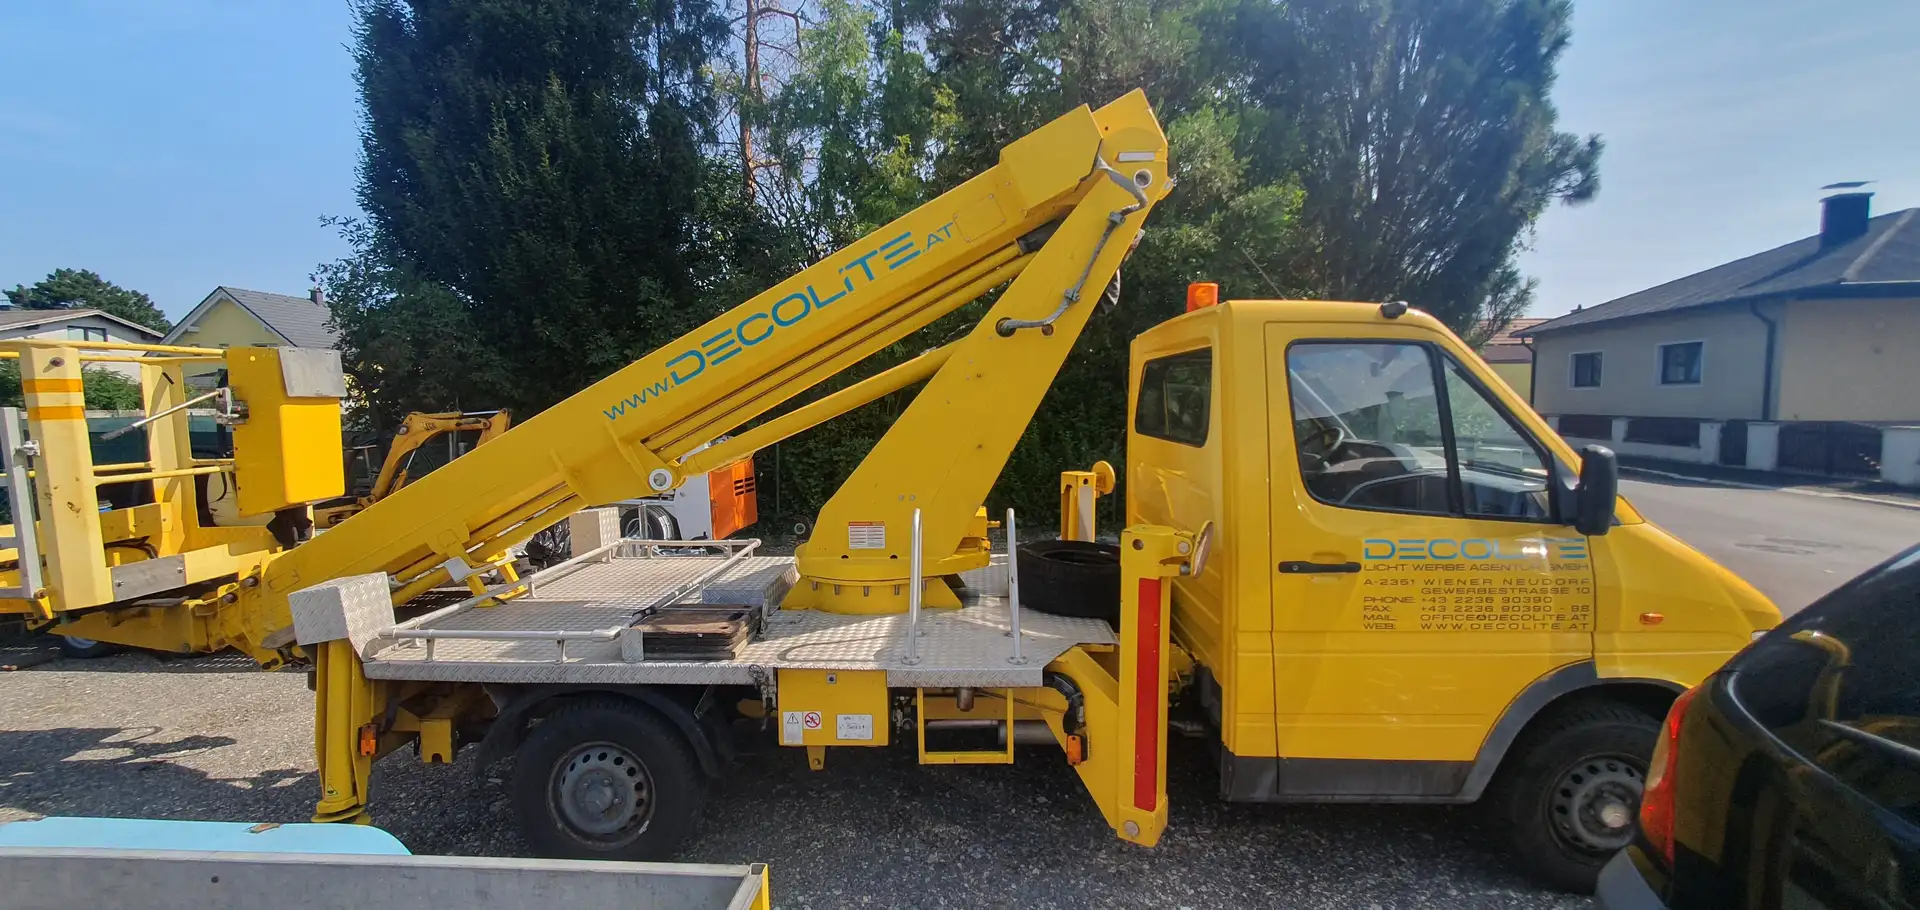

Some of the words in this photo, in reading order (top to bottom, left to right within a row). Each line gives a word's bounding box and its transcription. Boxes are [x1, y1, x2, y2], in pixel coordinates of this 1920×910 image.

[1363, 538, 1587, 560] DECOLE
[1364, 563, 1408, 572] LICHT
[1412, 563, 1465, 572] WERBE
[1550, 563, 1589, 571] GMBH
[1502, 578, 1590, 586] NEUDORF
[1421, 587, 1569, 595] GEWERBESTRASSE
[1576, 587, 1591, 595] 10
[1422, 596, 1447, 604] +43
[1454, 596, 1494, 604] 2236
[1501, 596, 1553, 604] 90390
[1421, 605, 1447, 613] +43
[1454, 605, 1494, 613] 2236
[1420, 613, 1589, 621] OFFICE@DECOLITE.AT
